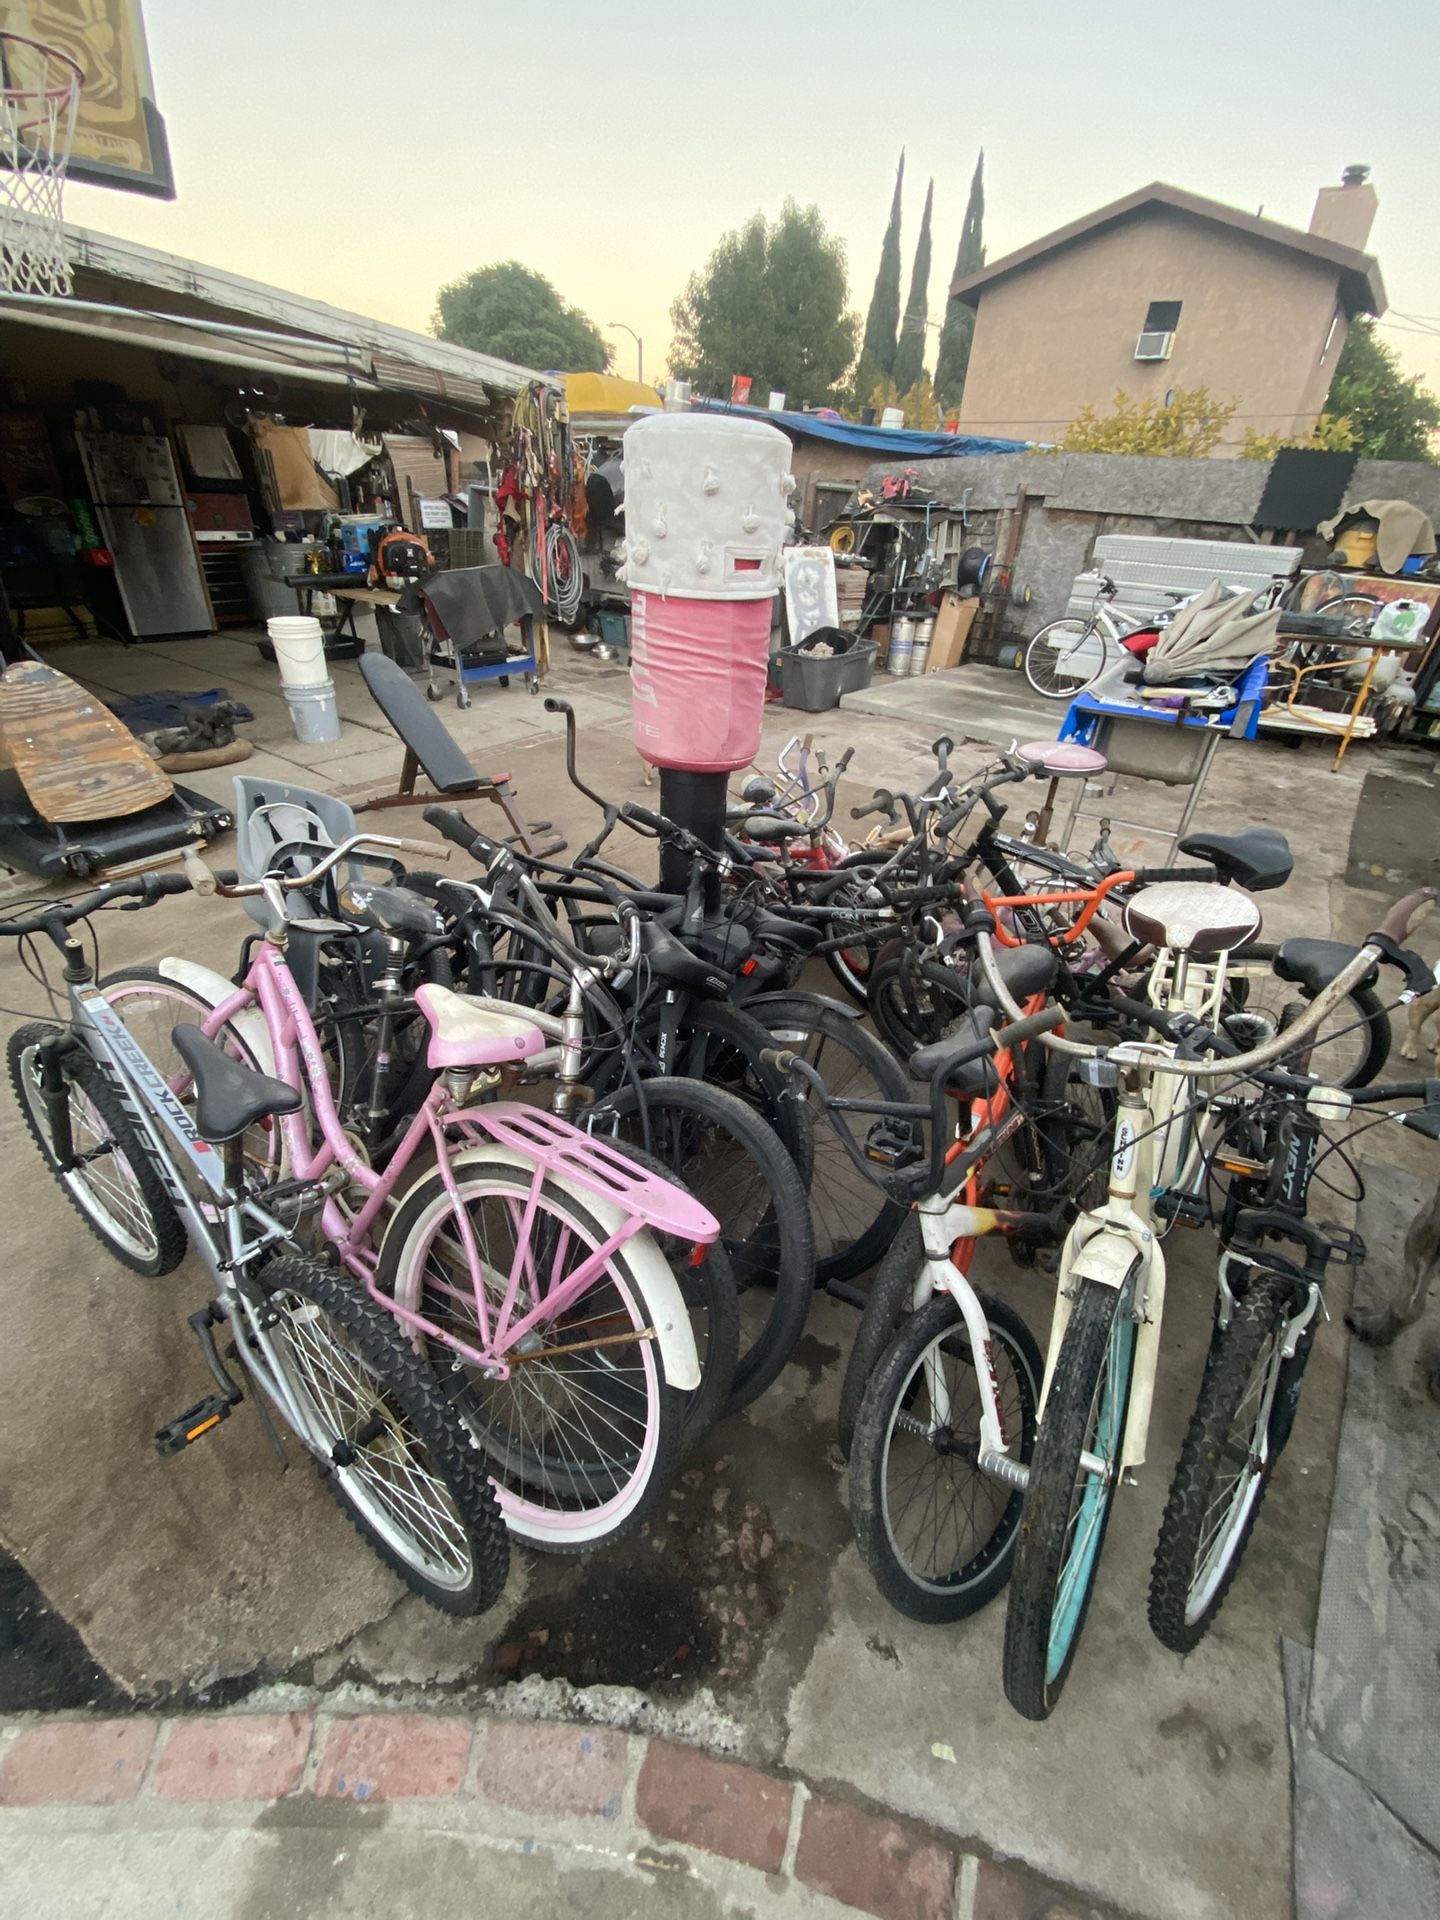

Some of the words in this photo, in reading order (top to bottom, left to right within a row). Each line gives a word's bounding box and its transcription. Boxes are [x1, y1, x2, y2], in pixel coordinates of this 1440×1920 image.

[106, 1026, 161, 1089] CREEK
[153, 1087, 200, 1142] ROCK
[1281, 1132, 1301, 1200] NEXT
